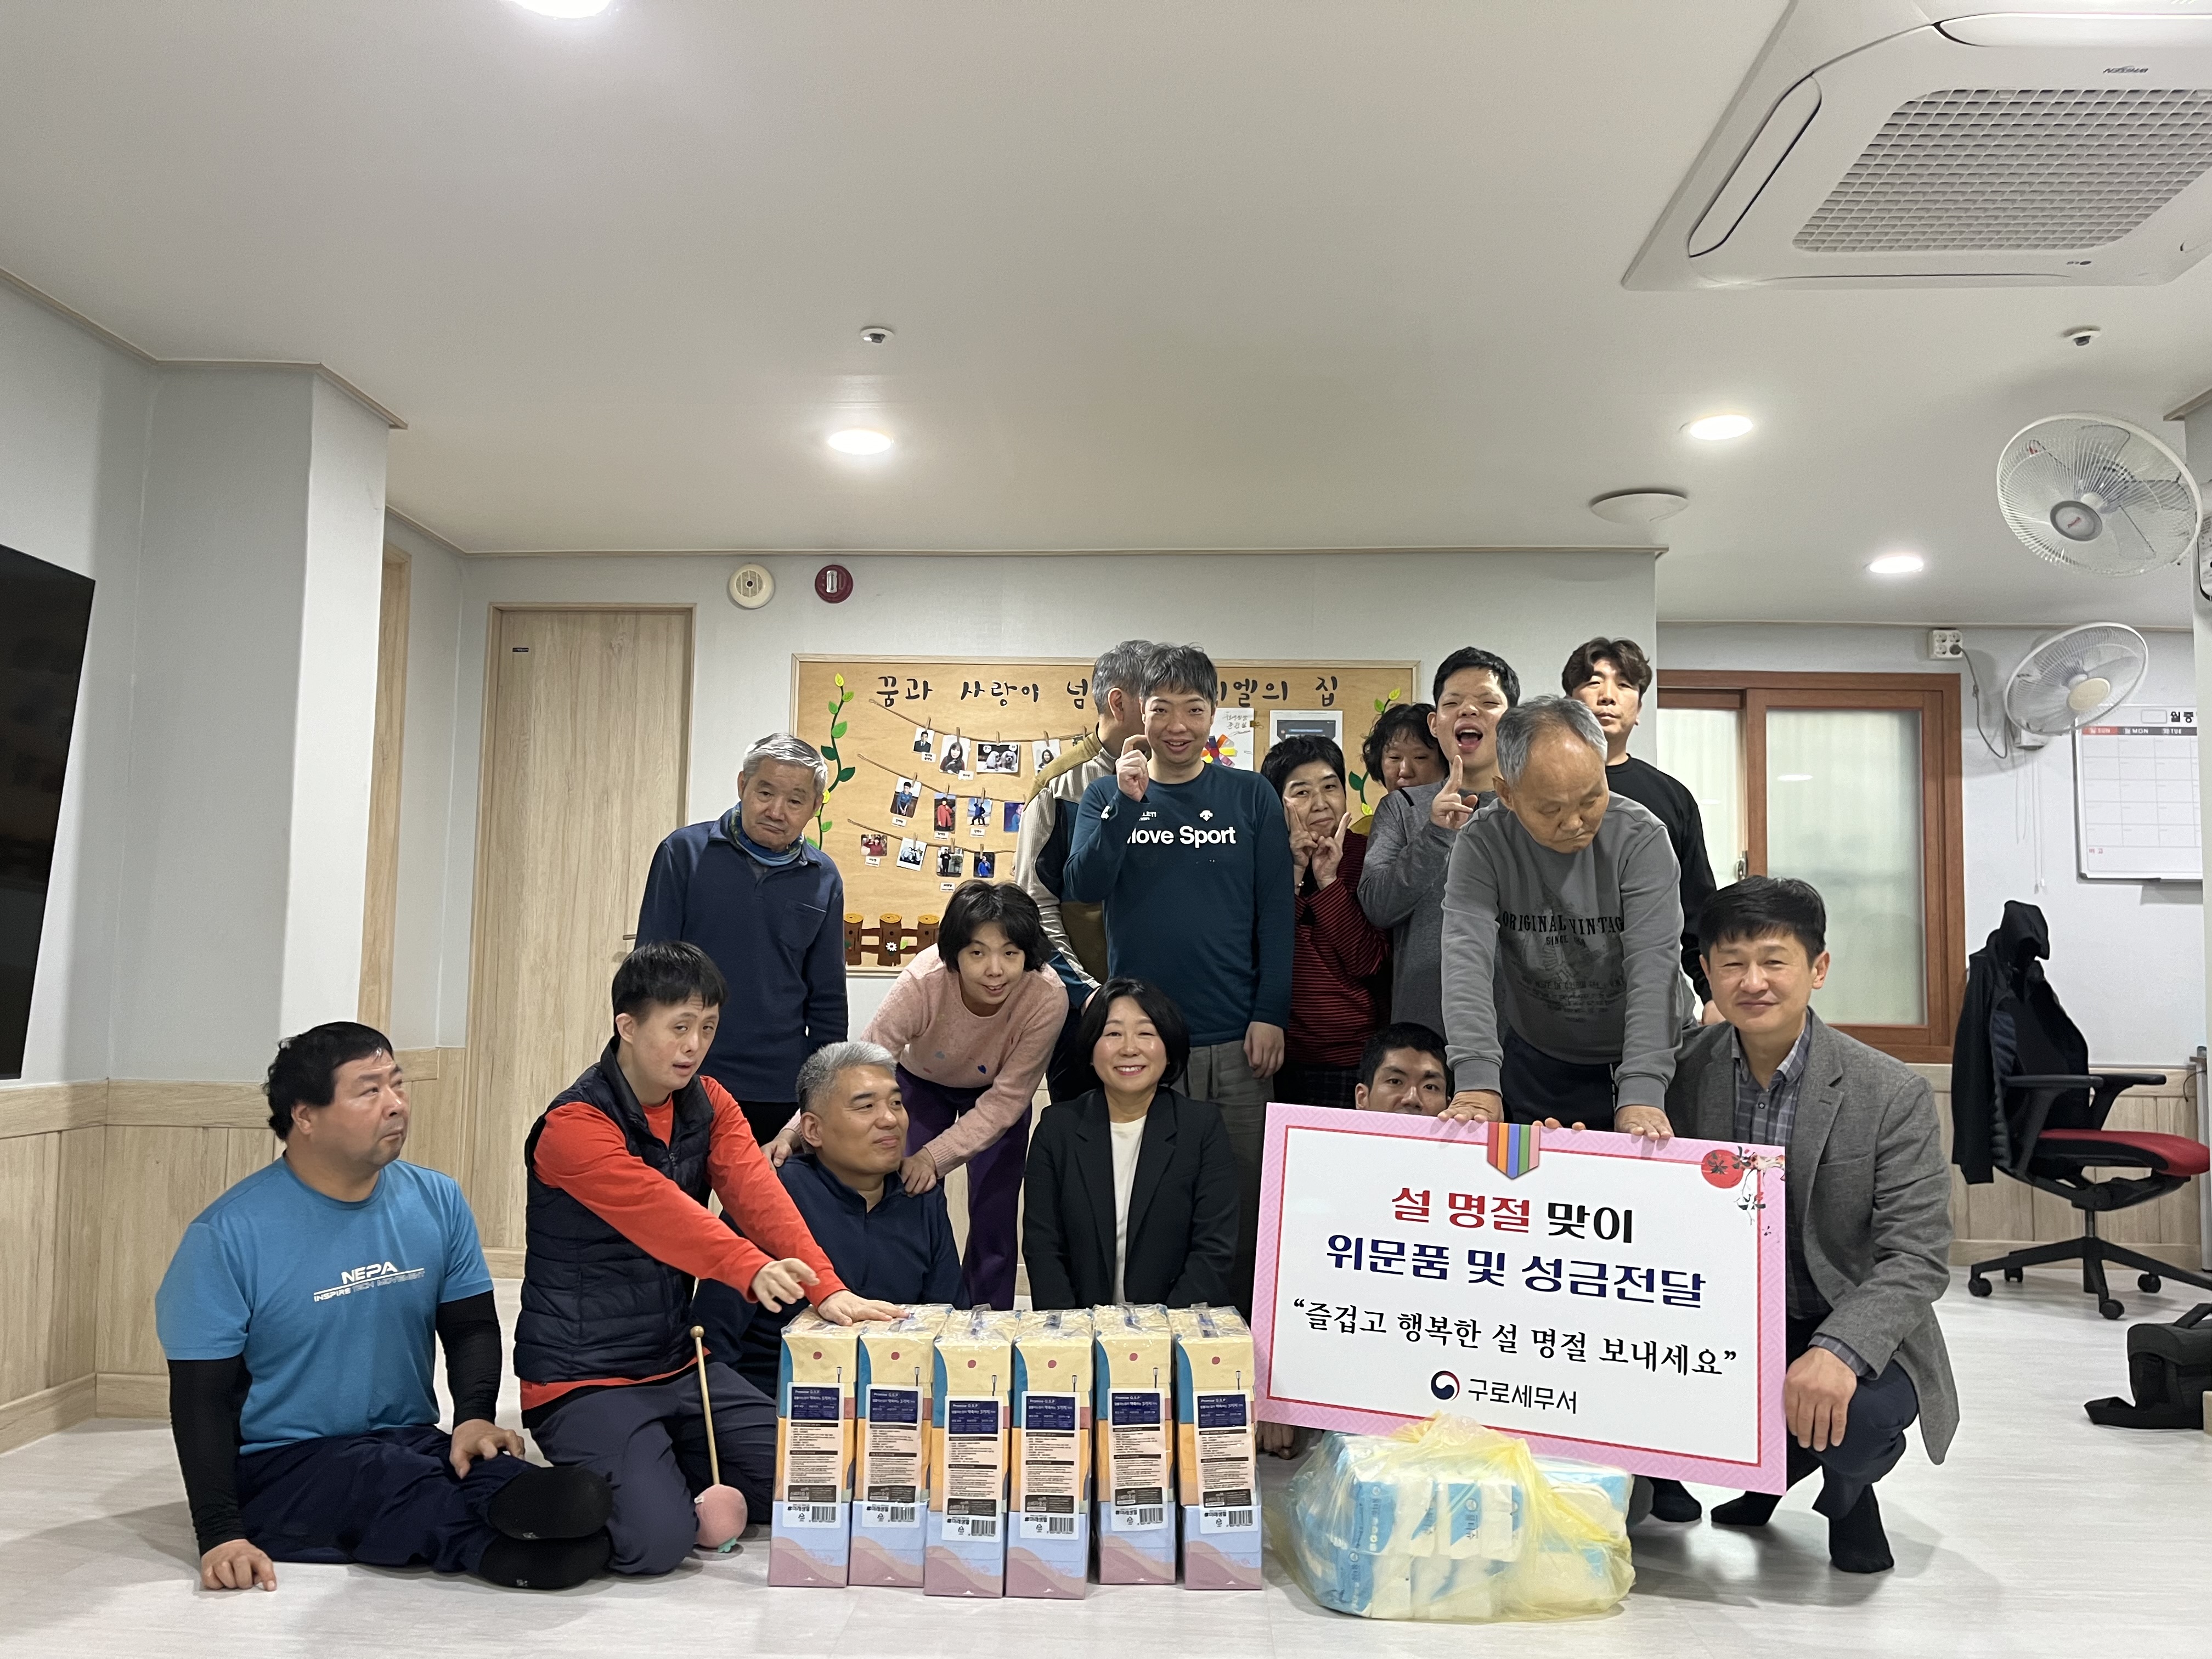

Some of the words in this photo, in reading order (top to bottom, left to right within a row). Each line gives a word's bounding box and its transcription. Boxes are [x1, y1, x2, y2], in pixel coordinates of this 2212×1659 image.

[877, 676, 933, 708] 꿈과
[960, 680, 1039, 707] 사랑이
[1315, 676, 1338, 707] 집
[1179, 826, 1236, 849] Sport
[1502, 911, 1567, 933] ORIGINAL
[1568, 916, 1624, 935] VINTAG
[1391, 1187, 1431, 1223] 설
[1448, 1192, 1530, 1233] 명절
[1547, 1201, 1633, 1244] 맞이
[341, 1261, 398, 1284] NEPA
[1327, 1234, 1450, 1280] 위문품
[1467, 1249, 1506, 1287] 및
[1521, 1256, 1706, 1308] 성금전달
[313, 1287, 351, 1302] INSPIRE
[1293, 1297, 1387, 1335] “즐겁고
[1397, 1312, 1482, 1349] 행복한
[1492, 1323, 1518, 1355] 설
[1531, 1328, 1587, 1363] 명절
[1599, 1338, 1737, 1376] 보내세요”
[1468, 1378, 1577, 1414] 구로세무서
